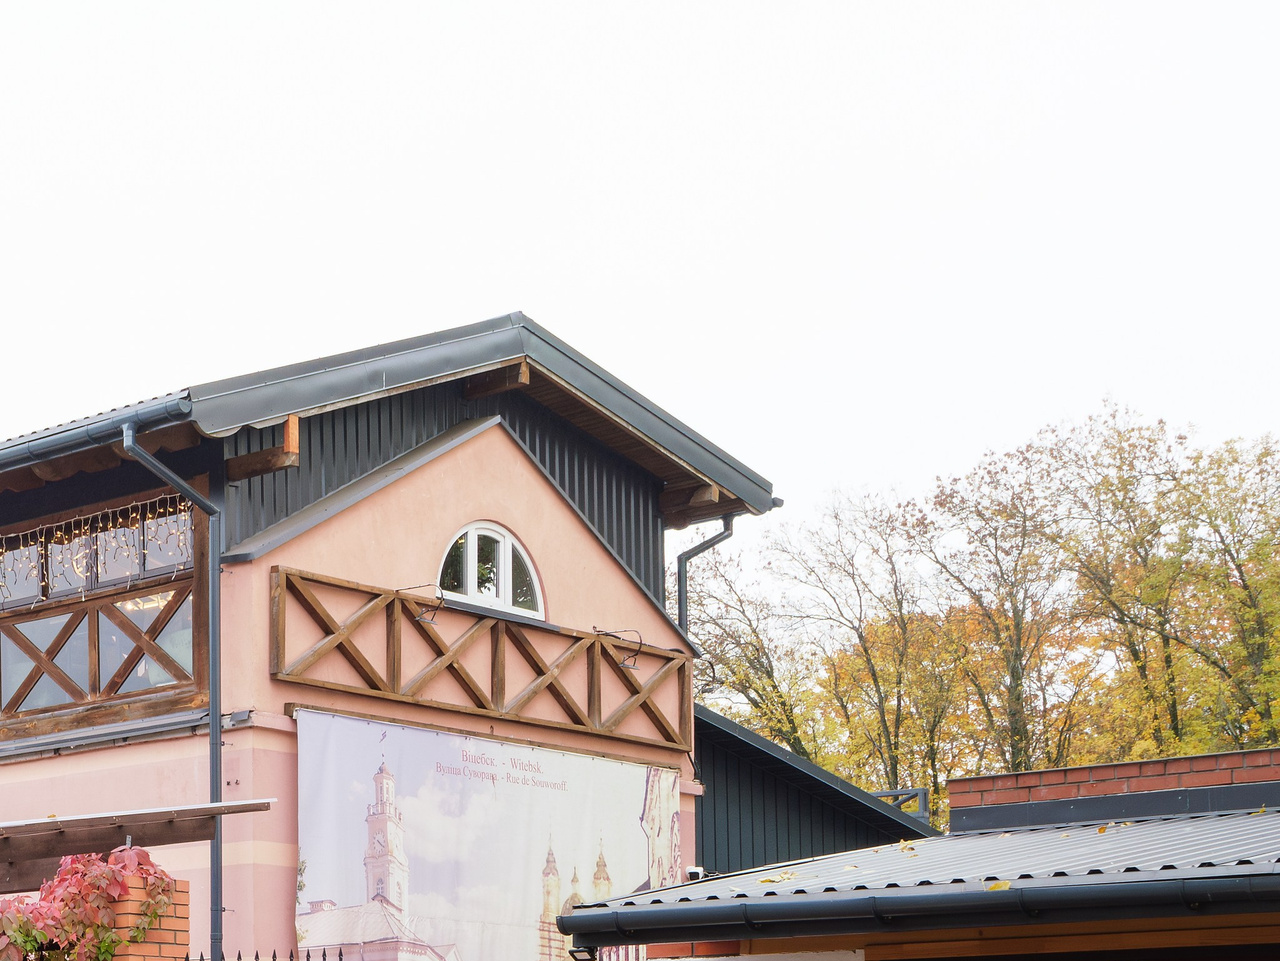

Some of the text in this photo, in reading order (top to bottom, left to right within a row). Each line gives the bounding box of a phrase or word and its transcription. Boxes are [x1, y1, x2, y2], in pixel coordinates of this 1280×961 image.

[436, 761, 461, 776] Вуліца
[506, 772, 519, 784] Rue
[521, 775, 530, 786] de
[510, 757, 544, 774] Witebsk.
